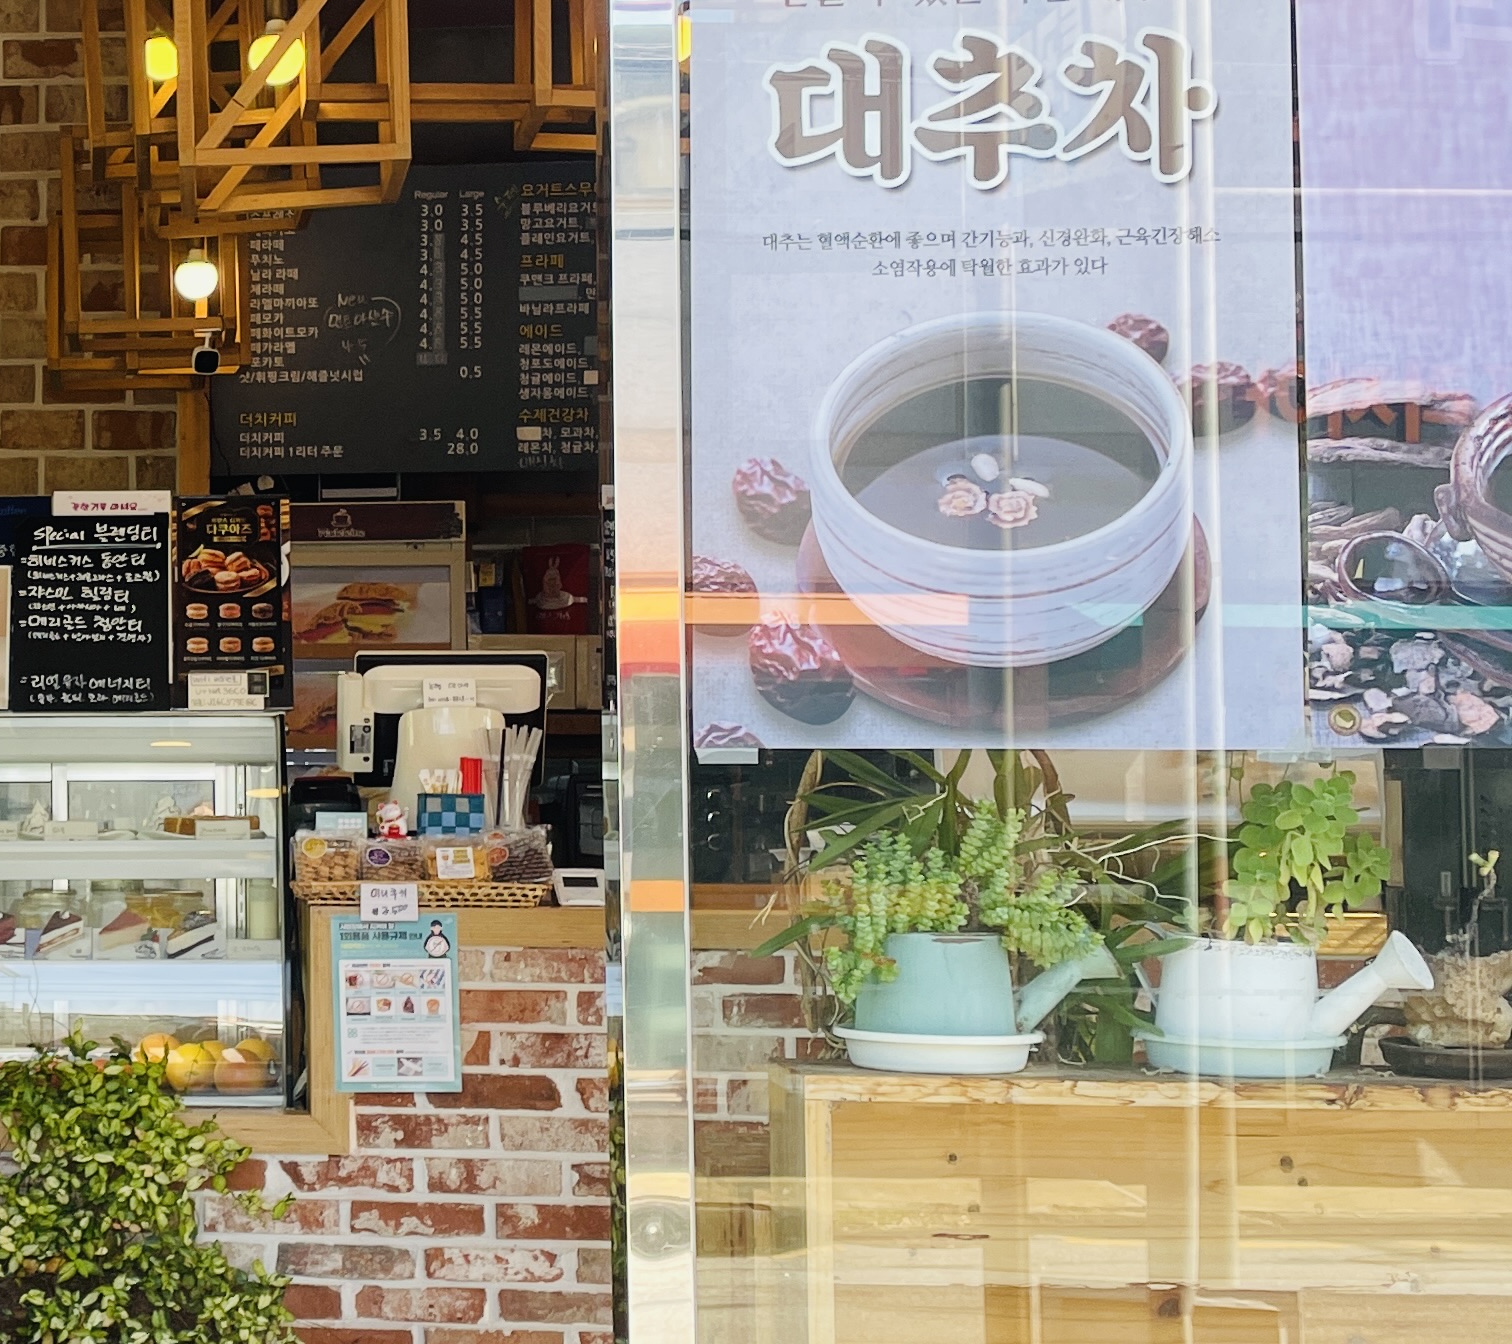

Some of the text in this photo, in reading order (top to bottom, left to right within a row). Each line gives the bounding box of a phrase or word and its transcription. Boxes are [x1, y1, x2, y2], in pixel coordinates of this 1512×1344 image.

[768, 28, 1218, 188] 대추차
[521, 182, 596, 197] 요거트스무
[420, 204, 443, 217] 3.0
[460, 203, 483, 216] 3.5
[420, 218, 483, 232] 3.0 3.5
[459, 233, 483, 246] 4.5
[762, 232, 813, 252] 대추는
[817, 231, 901, 251] 혈액순환에
[905, 230, 956, 250] 좋으며
[961, 228, 1034, 249] 간기능과,
[1039, 227, 1112, 248] 신경완화,
[459, 248, 483, 260] 4.5
[520, 254, 565, 269] 프라페
[872, 256, 1108, 278] 소염작용에 탁월한 효과가 있다
[459, 263, 483, 275] 5.0
[459, 277, 483, 290] 5.0
[459, 292, 483, 304] 5.0
[459, 307, 483, 320] 5.5
[519, 302, 590, 316] 바닐라프라페
[459, 322, 483, 335] 5.5
[519, 323, 564, 339] 에이드
[459, 336, 483, 349] 5.5
[459, 366, 482, 379] 0.5
[239, 412, 297, 428] 더치커피
[519, 408, 589, 423] 수제건강차
[239, 428, 479, 444] 더치커피 3.5 4.0
[239, 446, 285, 459] 더치커피
[320, 445, 344, 458] 주문
[447, 442, 479, 455] 28.0
[93, 523, 158, 543] 블렌딩티
[206, 523, 253, 535] 다쿠아즈
